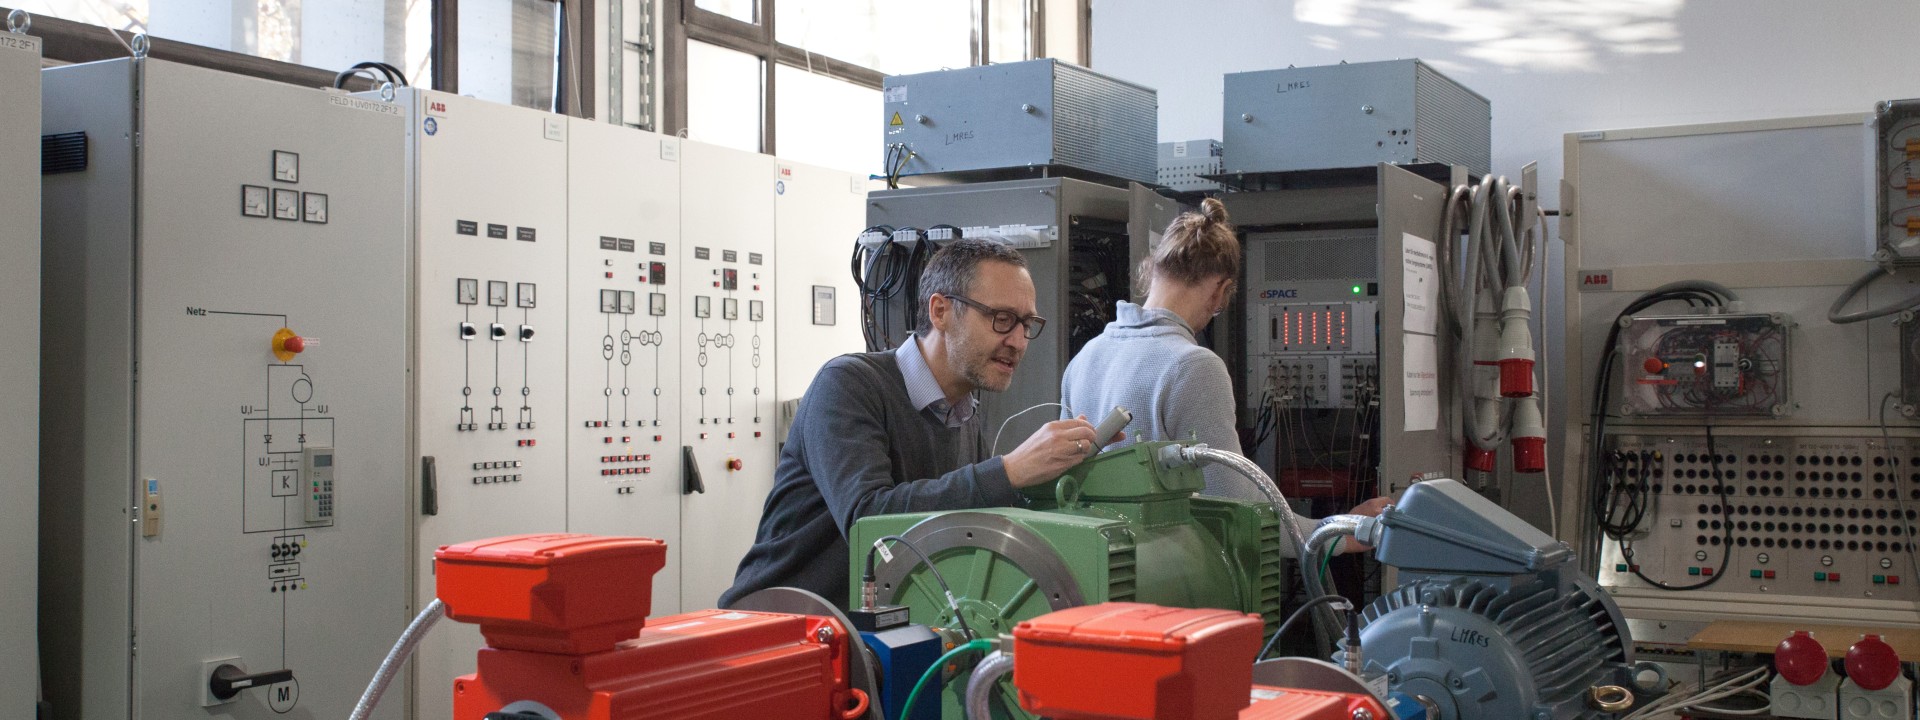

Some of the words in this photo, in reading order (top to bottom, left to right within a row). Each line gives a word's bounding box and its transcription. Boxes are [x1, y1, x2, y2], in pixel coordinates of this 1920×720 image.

[330, 95, 349, 106] FELD
[430, 101, 446, 112] ABB
[944, 130, 975, 146] LMRES
[781, 167, 791, 176] ABB
[1583, 274, 1608, 285] ABB
[1259, 289, 1298, 299] dSPACE
[186, 306, 207, 316] Netz
[282, 475, 290, 489] K
[1450, 626, 1490, 648] LMRES
[277, 686, 290, 702] M
